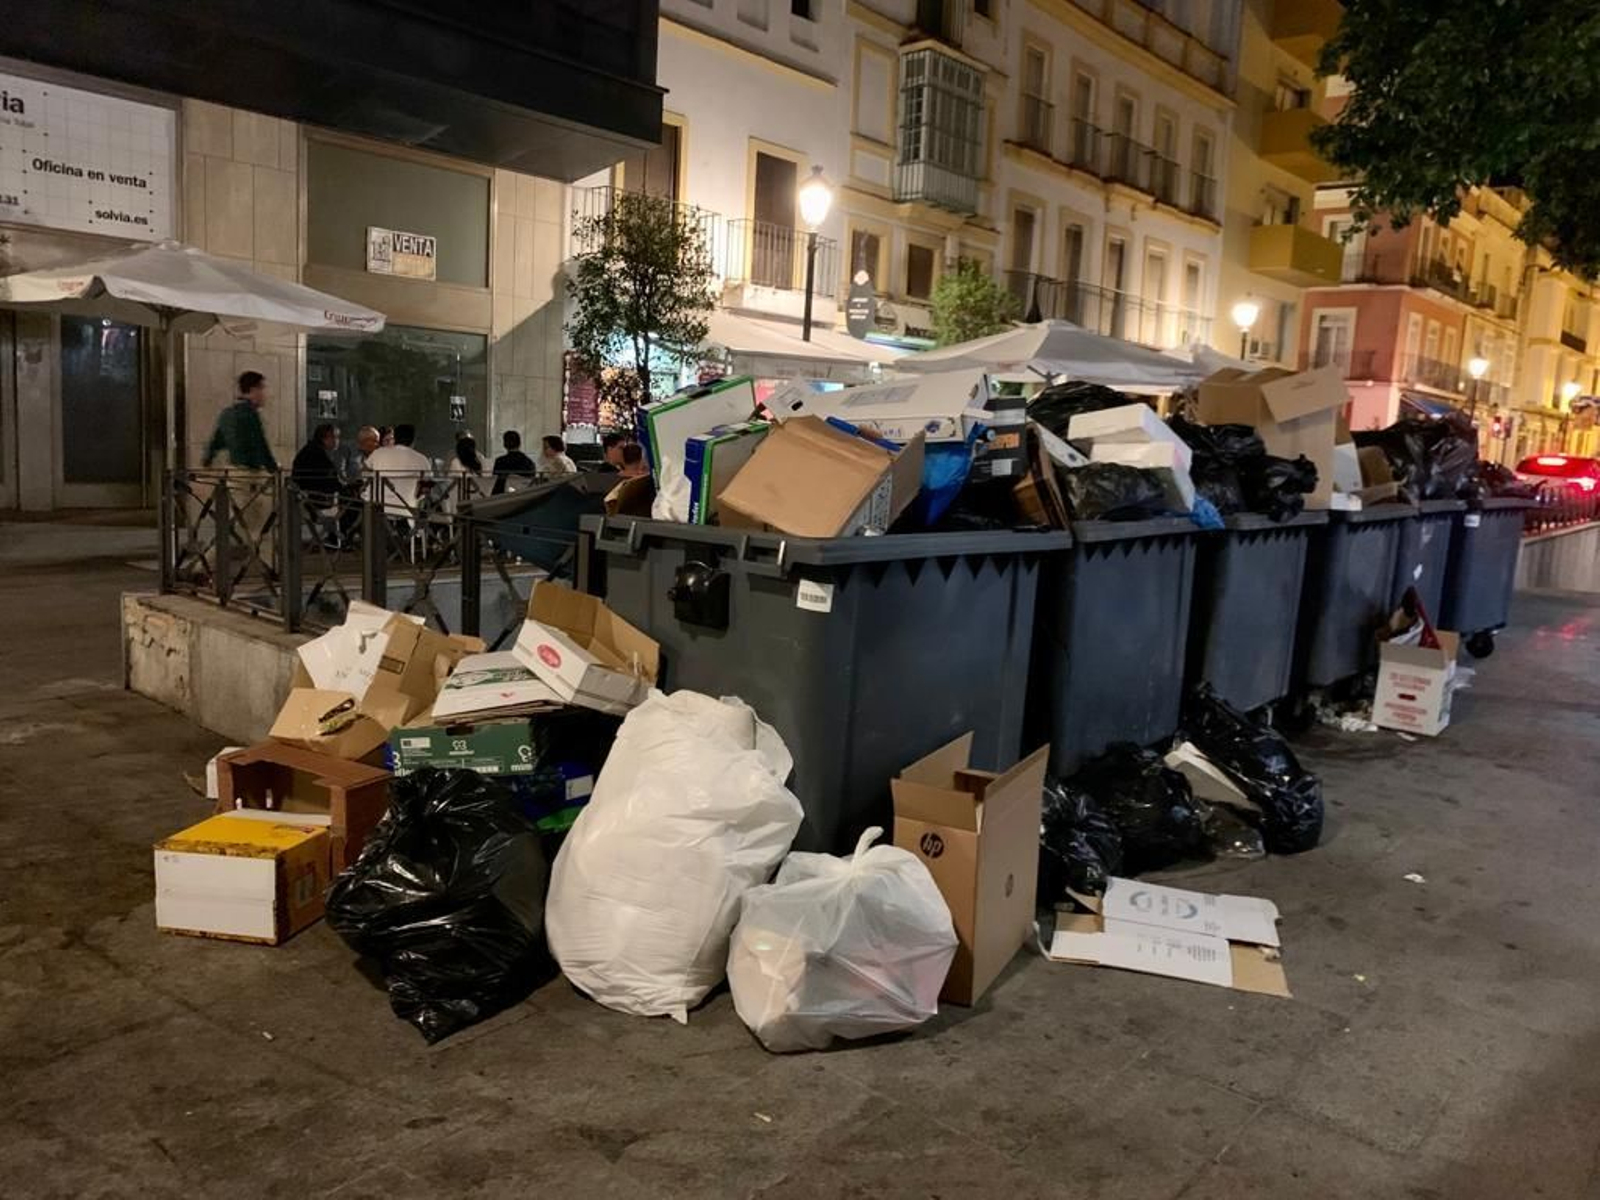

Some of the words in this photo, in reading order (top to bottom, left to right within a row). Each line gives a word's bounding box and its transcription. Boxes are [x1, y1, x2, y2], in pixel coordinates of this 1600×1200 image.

[0, 90, 24, 114] ia
[32, 157, 83, 178] Oficina
[87, 169, 105, 182] en
[109, 173, 147, 188] venta
[95, 209, 148, 226] solvia.es
[394, 233, 433, 257] VENTA
[922, 831, 942, 858] hp
